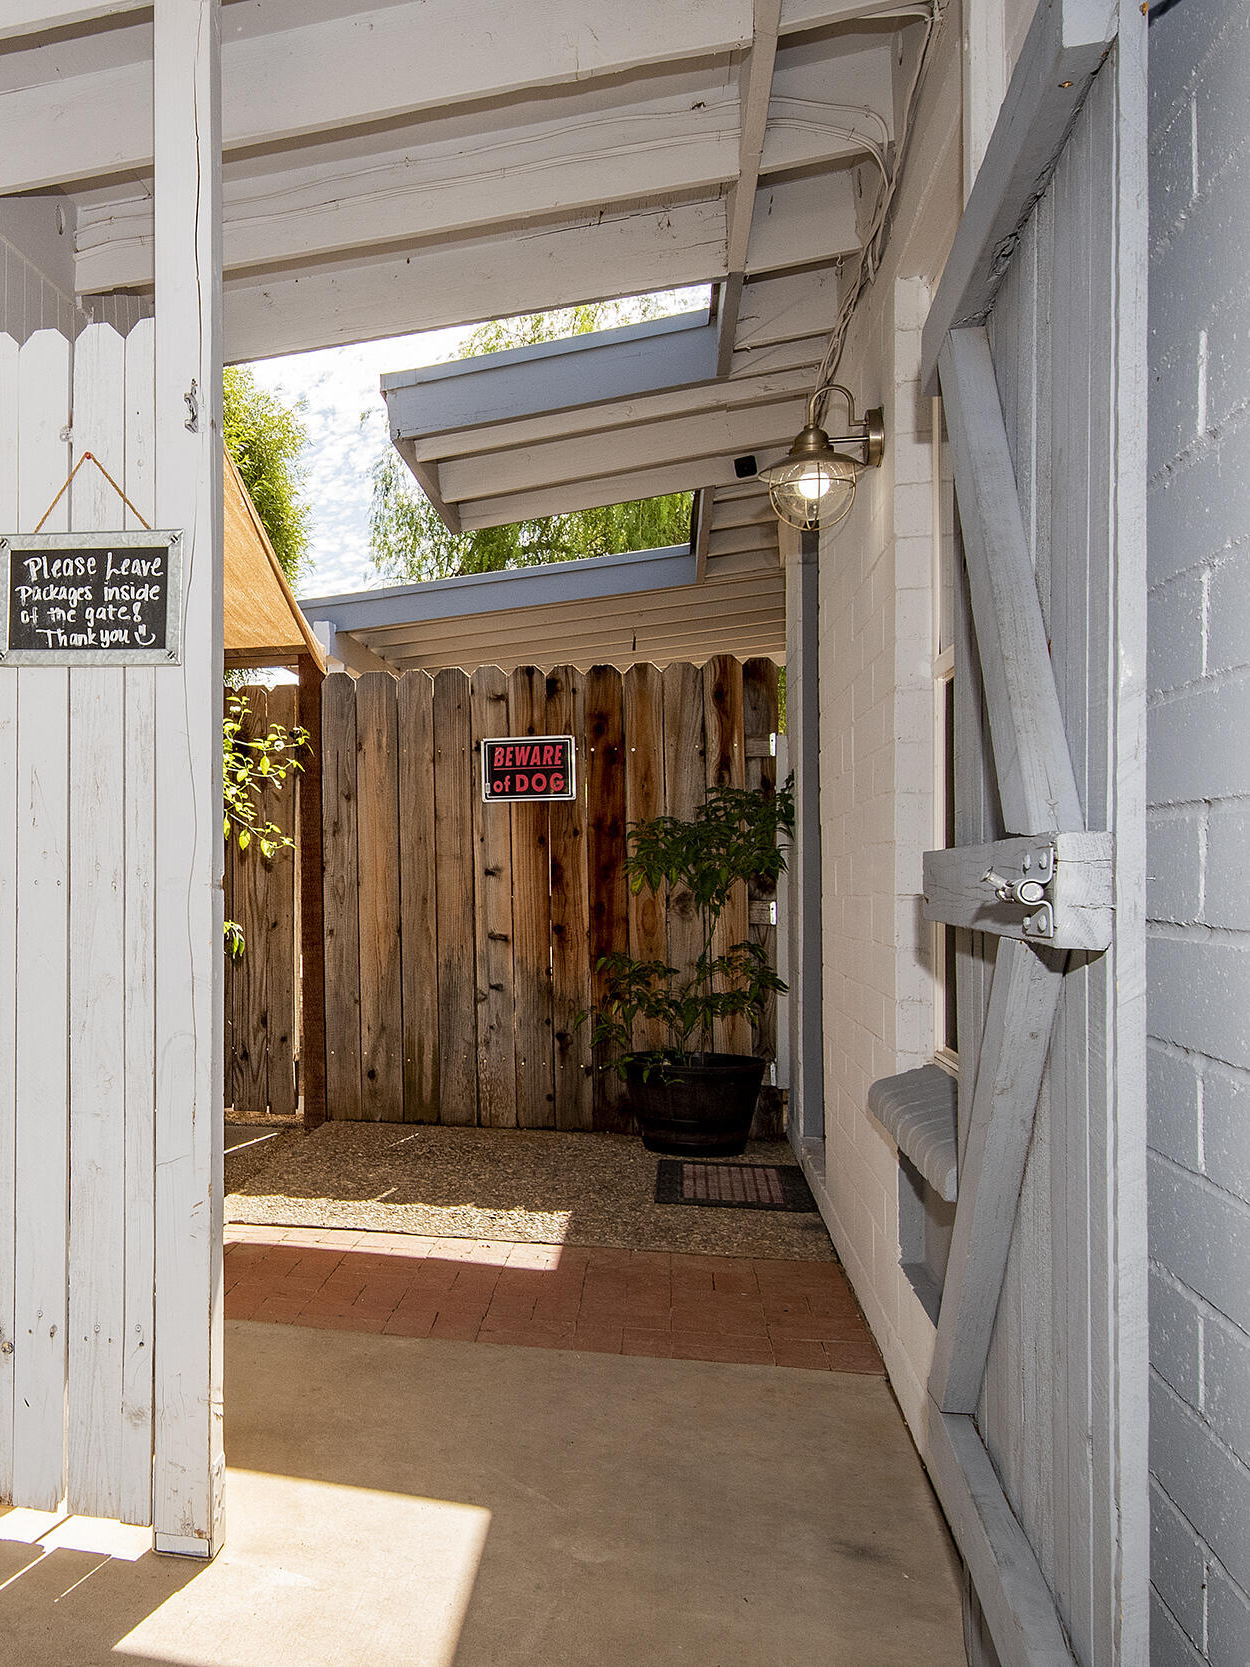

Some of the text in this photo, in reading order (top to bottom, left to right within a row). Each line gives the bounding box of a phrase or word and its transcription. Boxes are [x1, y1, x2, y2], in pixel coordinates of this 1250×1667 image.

[23, 552, 164, 582] Please Leave
[103, 581, 161, 602] inside
[20, 606, 39, 624] of
[35, 627, 131, 648] Thank you
[493, 745, 563, 767] BEWARE
[493, 772, 565, 793] of DOG
